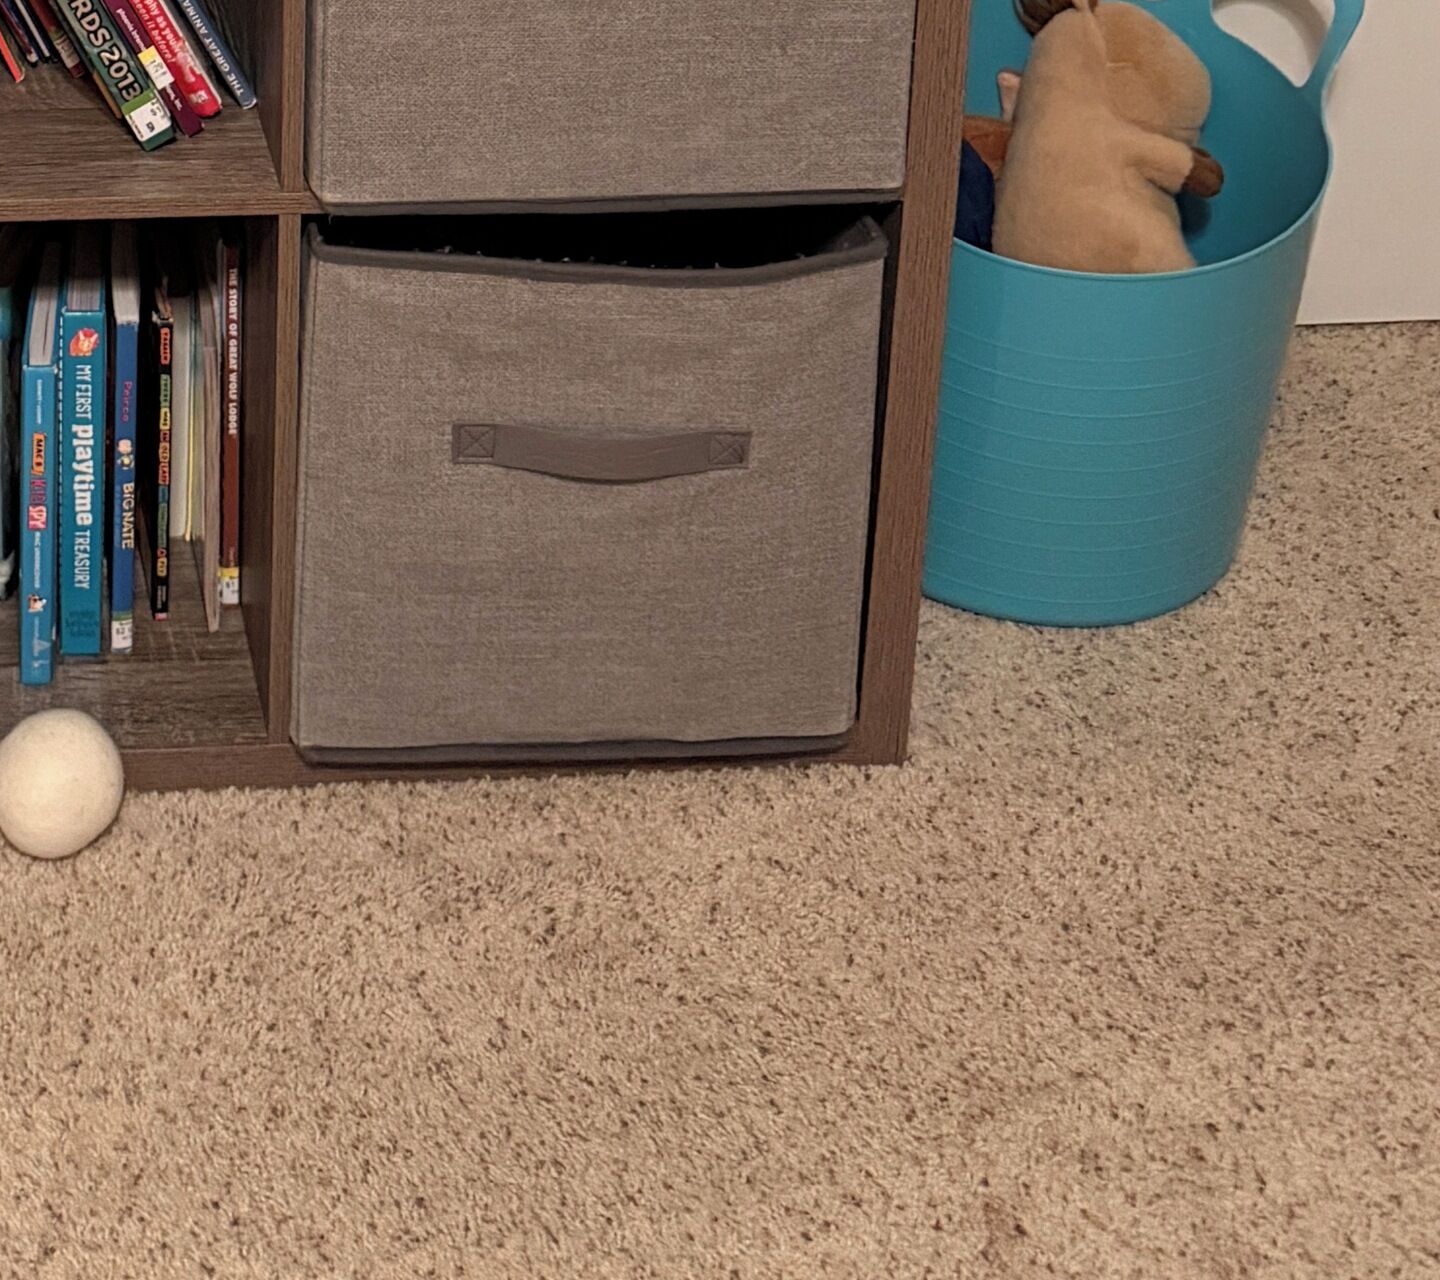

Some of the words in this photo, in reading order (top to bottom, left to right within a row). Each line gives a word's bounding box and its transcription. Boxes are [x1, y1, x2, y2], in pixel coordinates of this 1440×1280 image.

[133, 0, 150, 21] seen
[151, 27, 176, 63] before!
[204, 36, 230, 74] GREAT
[99, 48, 143, 101] 2013
[231, 78, 244, 97] THE
[228, 268, 238, 287] THE
[228, 289, 238, 321] STORY
[228, 322, 238, 337] OF
[228, 339, 238, 370] GREAT
[75, 364, 92, 381] MY
[228, 371, 238, 400] WOLF
[75, 384, 92, 420] FIRST
[228, 402, 238, 435] LODGE
[35, 439, 44, 458] MAC
[72, 424, 95, 526] playtime
[122, 511, 134, 549] NATE
[74, 530, 91, 589] TREASURY
